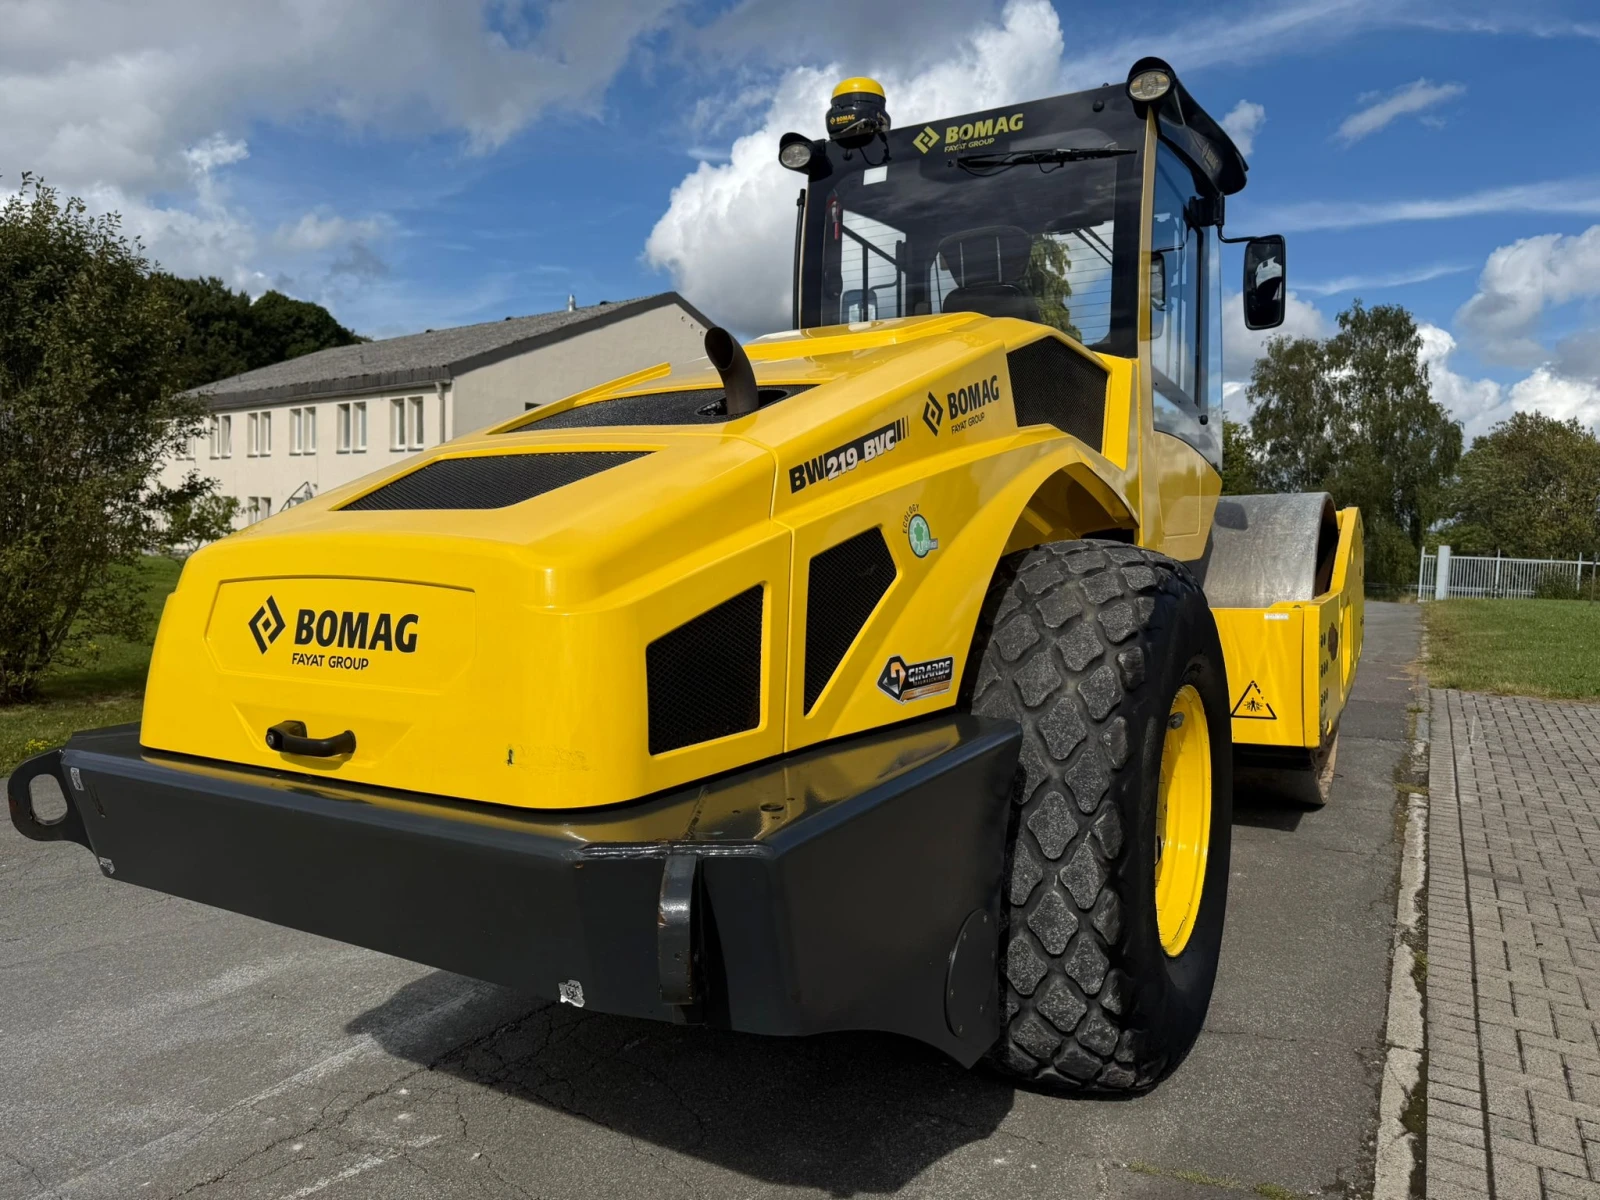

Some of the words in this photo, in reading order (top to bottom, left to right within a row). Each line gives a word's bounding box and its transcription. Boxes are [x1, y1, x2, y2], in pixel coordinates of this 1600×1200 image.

[945, 113, 1024, 144] BOMAG
[944, 142, 967, 153] FAYAT
[968, 137, 995, 149] GROUP
[947, 374, 999, 420] BOMAG
[951, 420, 967, 435] FAYAT
[967, 412, 985, 427] GROUP
[863, 429, 896, 463] BVC
[902, 503, 920, 534] ECOLOGY
[294, 609, 419, 653] BOMAG
[291, 653, 325, 667] FAYAT
[328, 656, 369, 670] GROUP
[908, 660, 951, 682] GIRARDS
